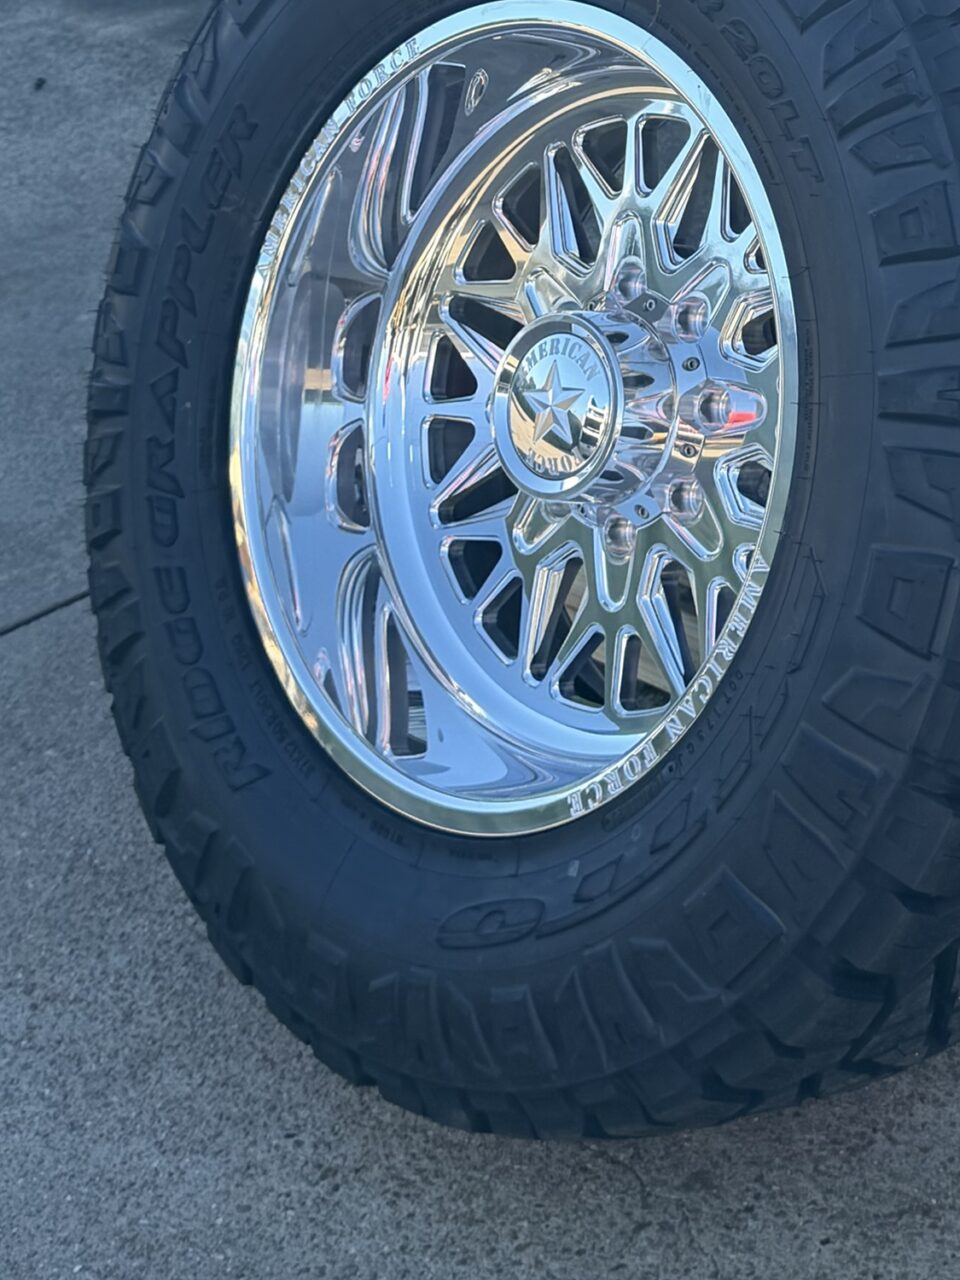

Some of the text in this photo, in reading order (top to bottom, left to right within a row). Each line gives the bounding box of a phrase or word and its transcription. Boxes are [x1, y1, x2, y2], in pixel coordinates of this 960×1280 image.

[254, 37, 421, 278] AMERICAN FORCE
[145, 100, 271, 794] RIDGE GRAPPLER
[662, 552, 769, 741] AMERICAN
[567, 741, 659, 817] FORCE
